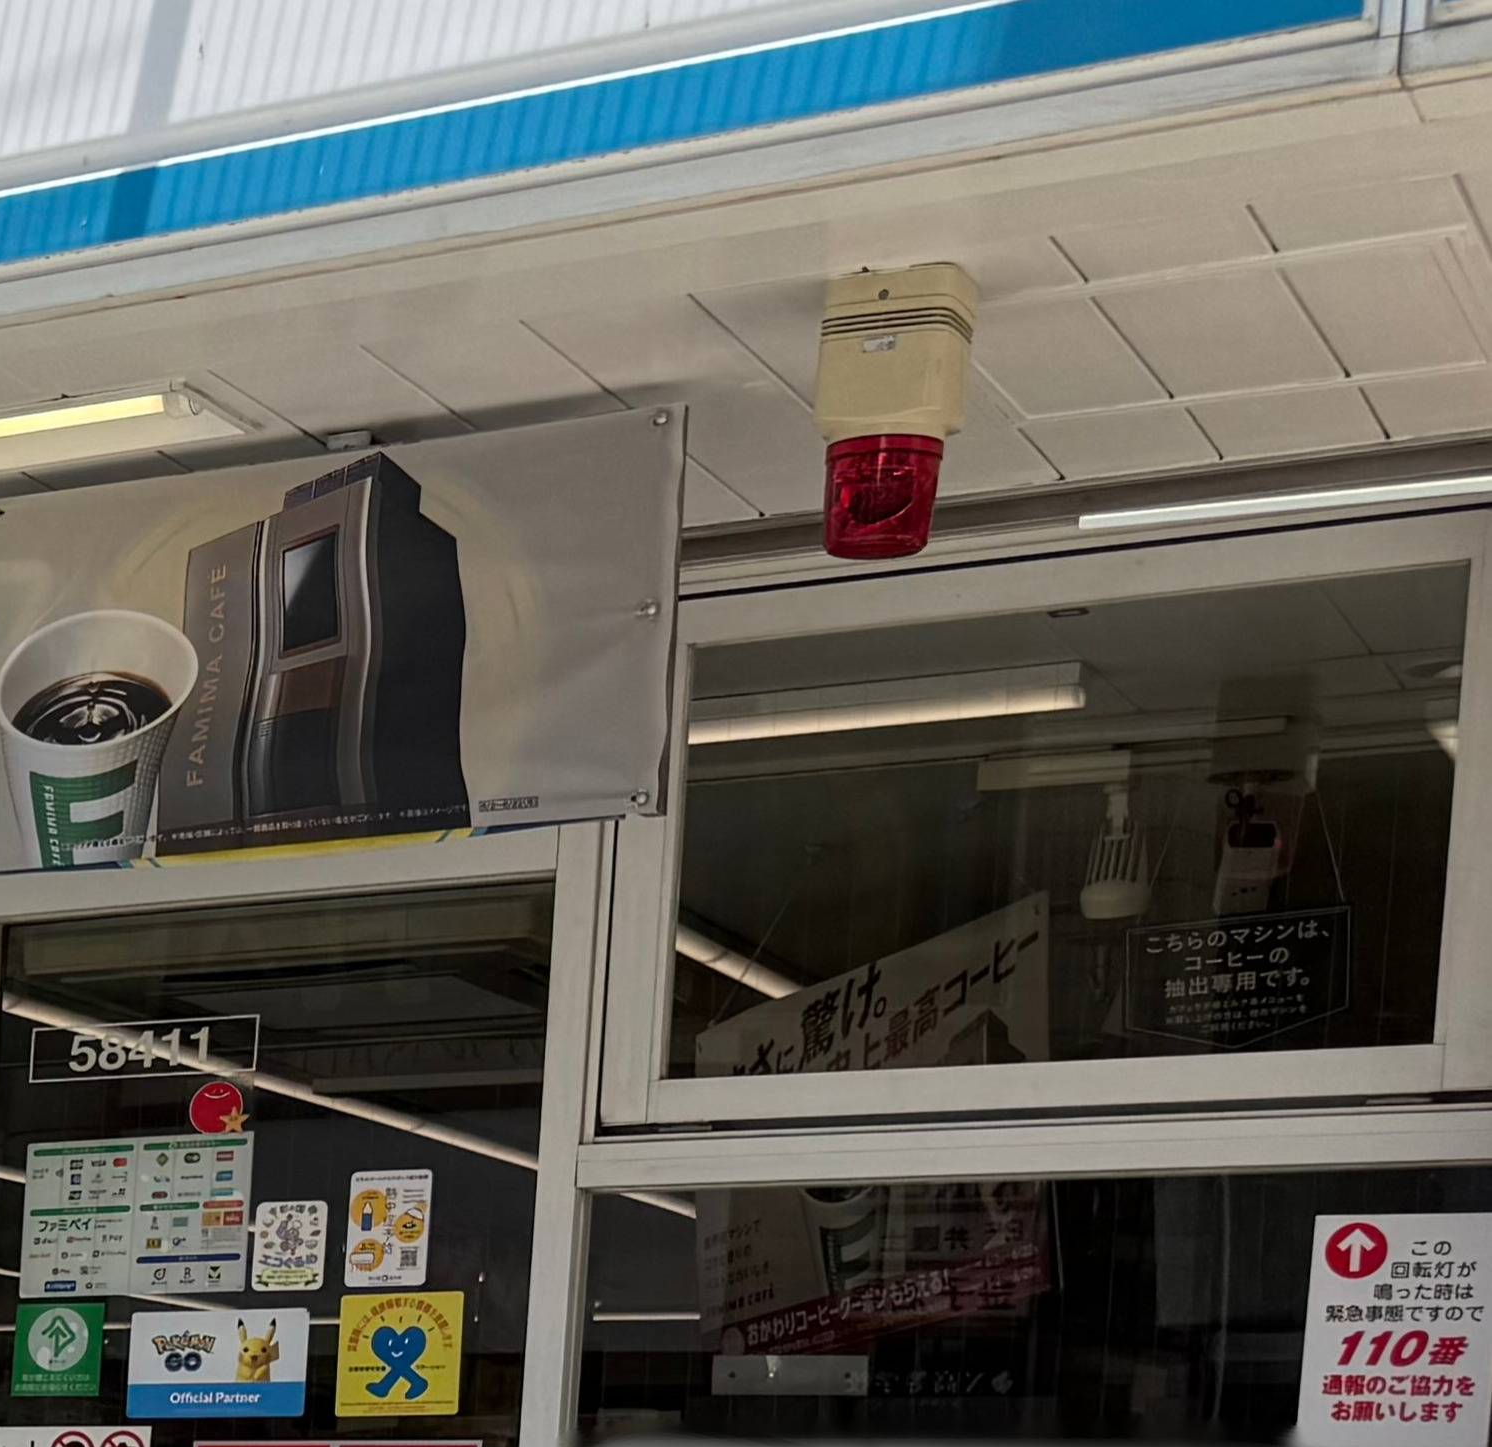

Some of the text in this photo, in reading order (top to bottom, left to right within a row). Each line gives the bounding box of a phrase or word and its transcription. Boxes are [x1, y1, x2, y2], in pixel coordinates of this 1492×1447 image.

[186, 654, 223, 788] FAMIMA
[1146, 919, 1330, 954] こちらのマシンは、
[1183, 947, 1290, 972] コーヒーの
[1164, 966, 1311, 998] 抽出専用です。
[67, 1026, 210, 1073] 58411
[38, 1217, 92, 1233] ファミペイ
[1410, 1240, 1452, 1256] この
[1390, 1261, 1478, 1280] 回転灯が
[1373, 1282, 1475, 1301] 鳴った時は
[1325, 1304, 1485, 1323] 緊急事態ですので
[1336, 1329, 1470, 1368] 110番
[165, 1352, 203, 1373] GO
[1321, 1374, 1477, 1397] 通報のご協力を
[169, 1391, 261, 1405] Official Partner
[1330, 1400, 1464, 1424] お願いします
